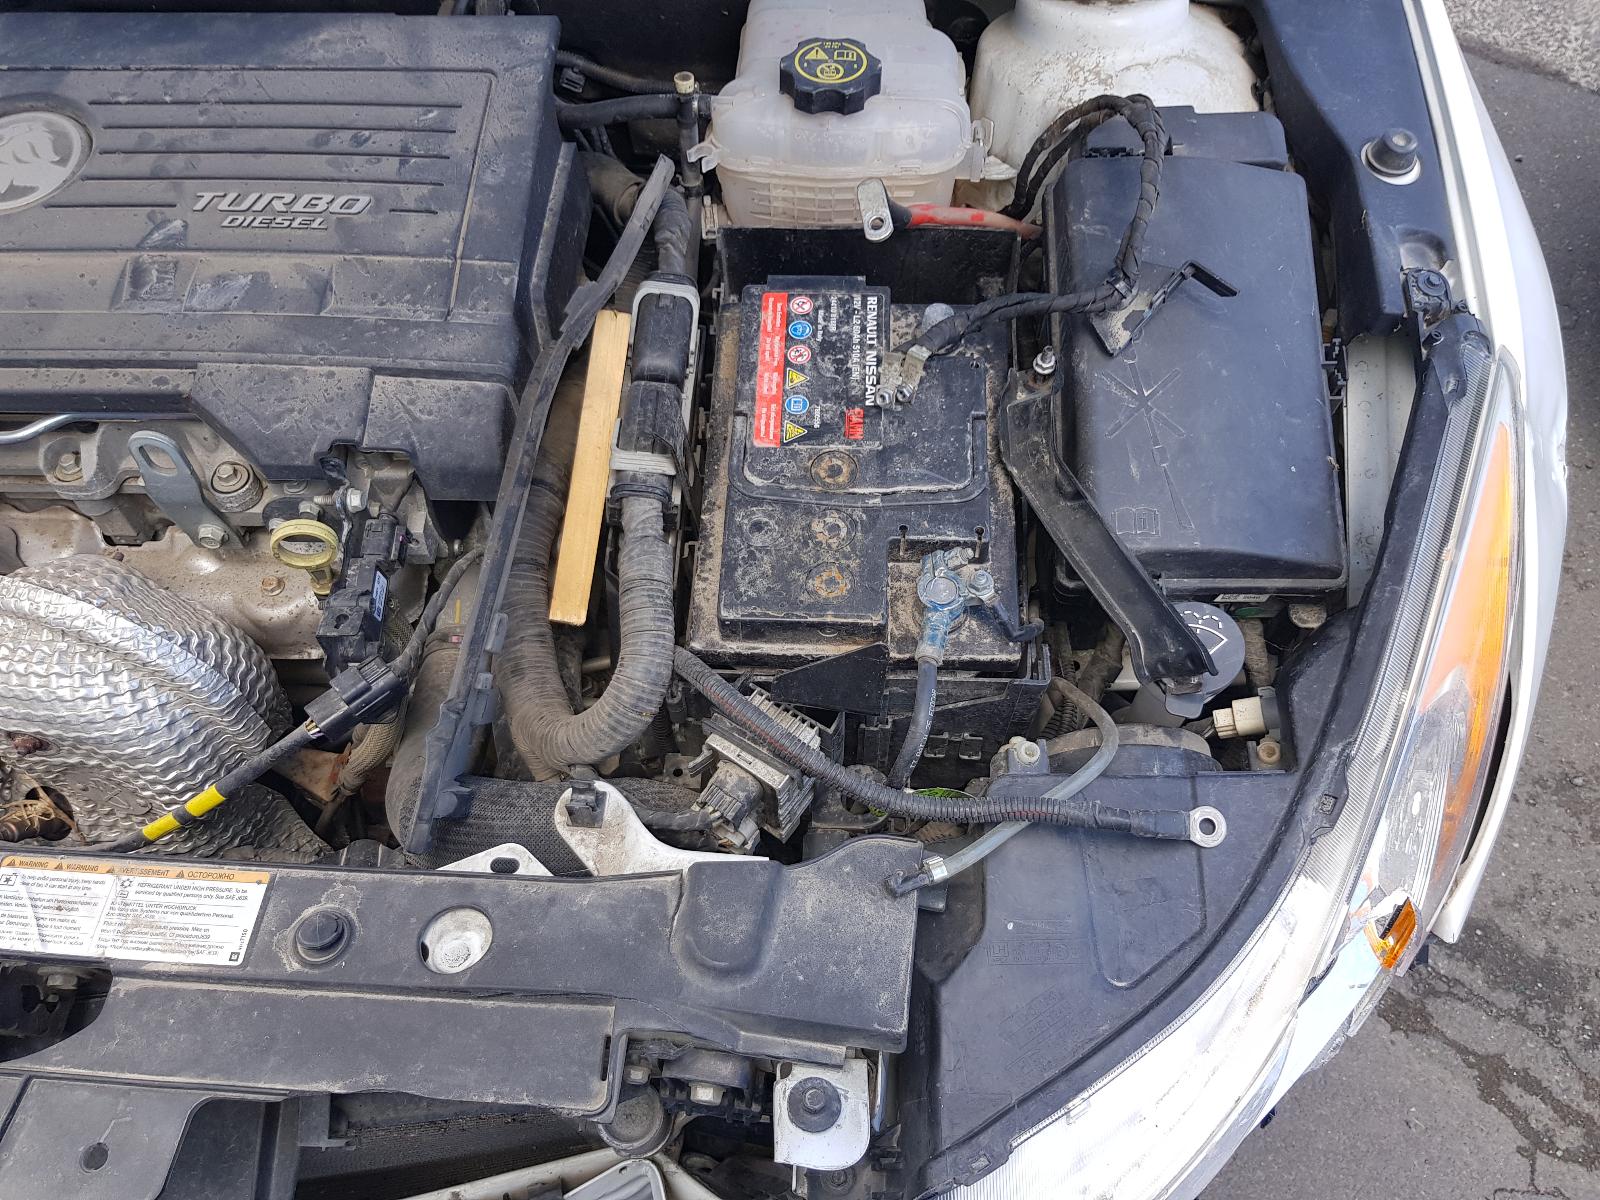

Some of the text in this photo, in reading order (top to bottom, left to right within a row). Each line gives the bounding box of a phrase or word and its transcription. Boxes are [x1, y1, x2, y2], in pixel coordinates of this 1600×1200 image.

[192, 192, 372, 215] TURBO
[220, 215, 328, 230] DIESEL
[853, 296, 861, 309] 12V
[865, 296, 878, 406] RENAULT NISSAN
[120, 867, 170, 876] VERTSSEMENT
[188, 871, 235, 880] ОСТОРОЖНО
